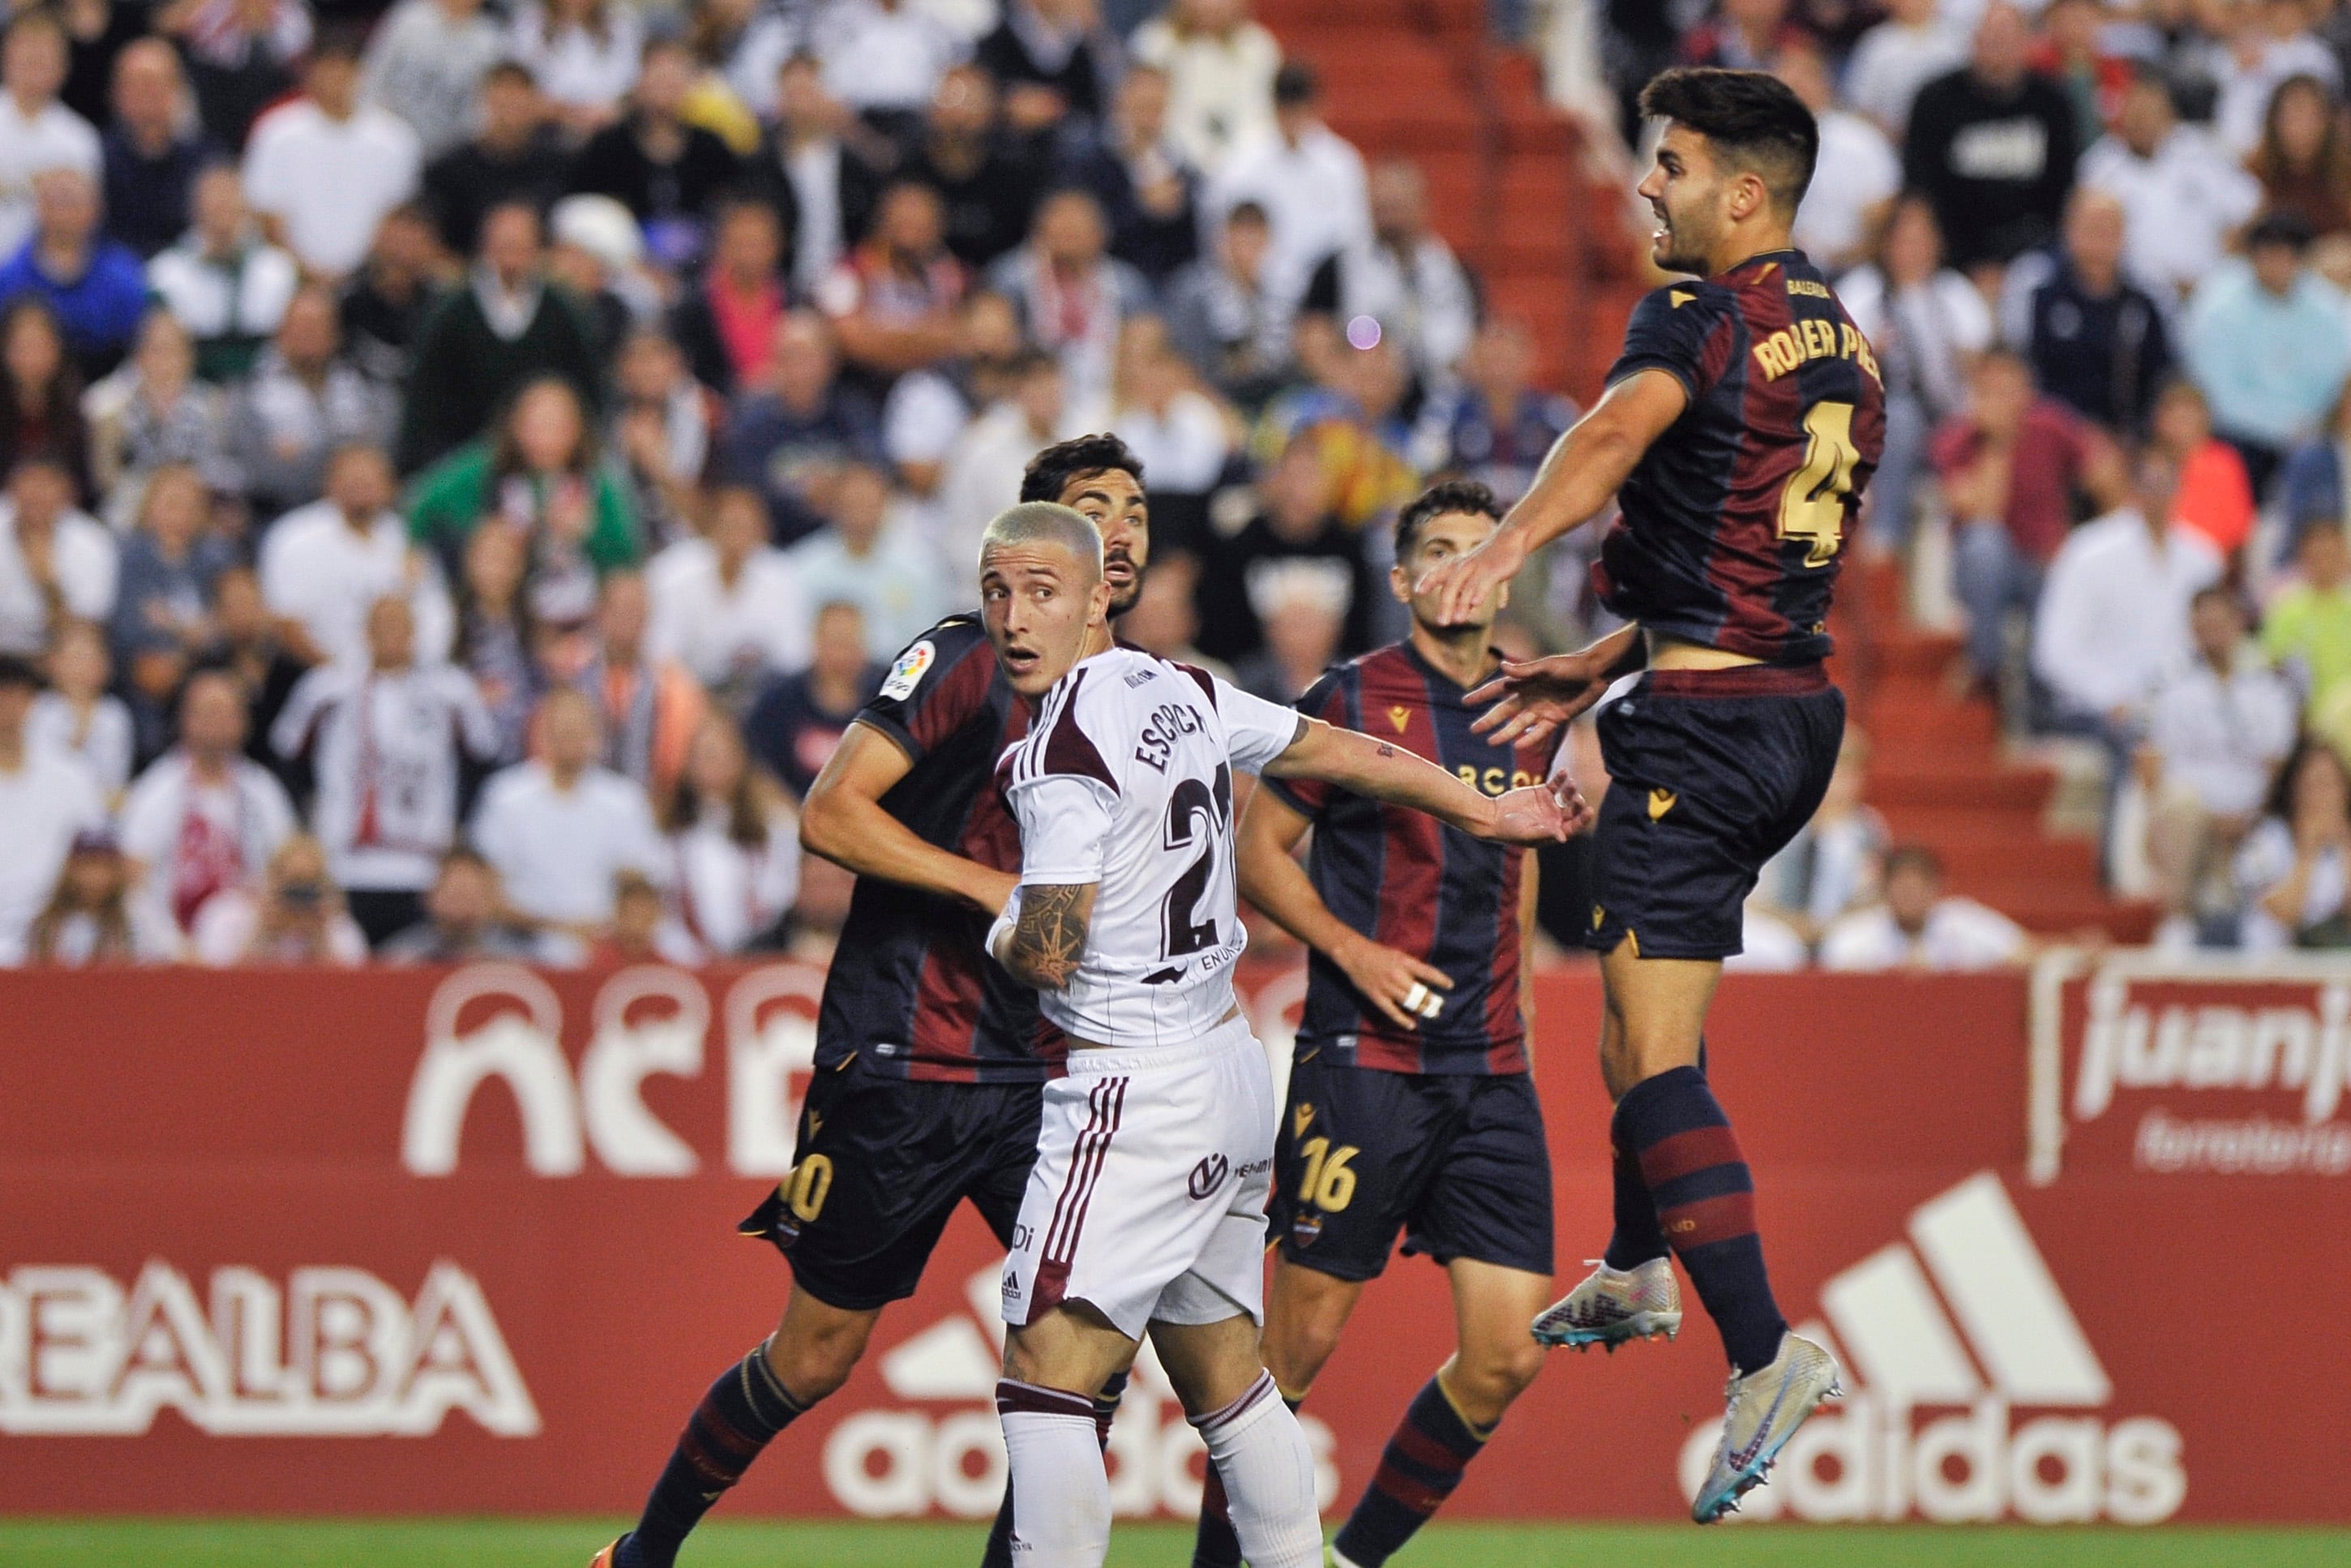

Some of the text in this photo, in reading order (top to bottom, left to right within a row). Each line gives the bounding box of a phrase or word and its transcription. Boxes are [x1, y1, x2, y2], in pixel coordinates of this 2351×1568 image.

[1752, 319, 1837, 383] ROBER
[1775, 401, 1861, 568] 4
[2071, 970, 2351, 1124] juanj
[1300, 1136, 1362, 1214] 16
[0, 1257, 544, 1437] EALBA
